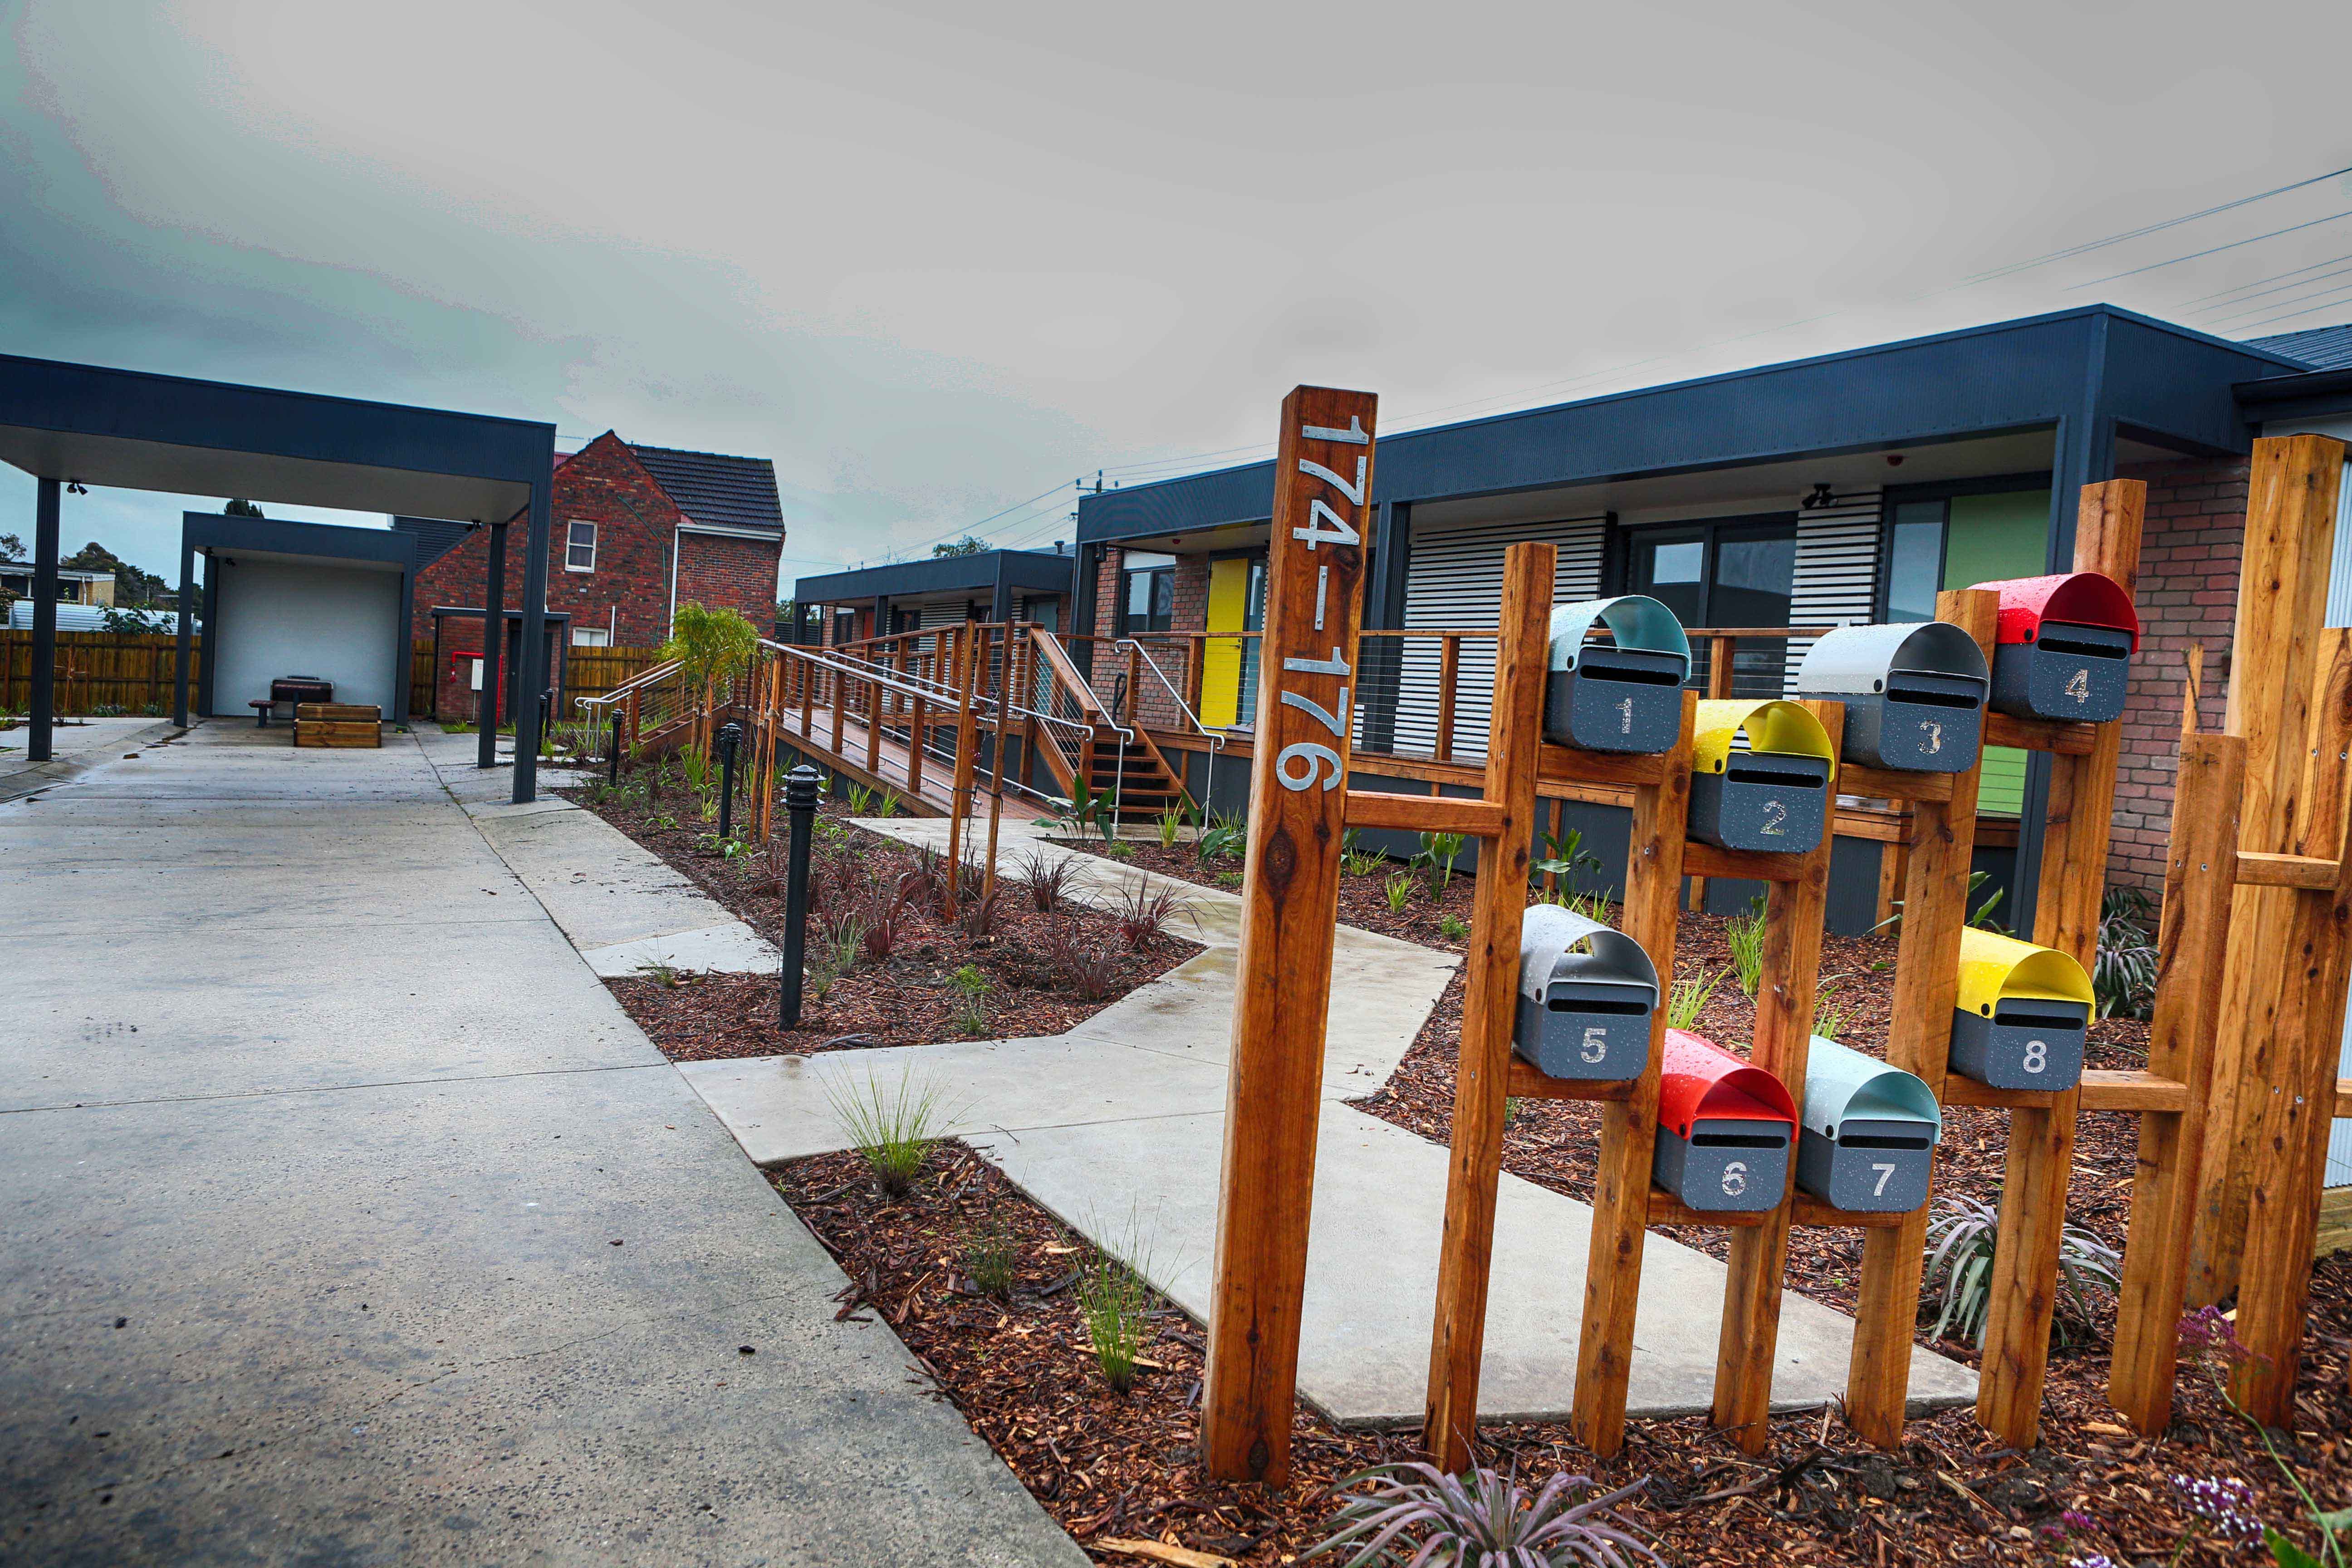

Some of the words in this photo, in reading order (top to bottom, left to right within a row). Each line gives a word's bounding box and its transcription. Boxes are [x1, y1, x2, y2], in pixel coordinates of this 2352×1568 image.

[1275, 416, 1369, 792] 174-176
[2065, 669, 2089, 703] 4
[1615, 698, 1632, 734] 1
[1917, 720, 1941, 754] 3
[1760, 801, 1786, 835] 2
[1581, 1028, 1607, 1063] 5
[2023, 1040, 2047, 1073] 8
[1722, 1161, 1747, 1198] 6
[1872, 1163, 1895, 1198] 7
